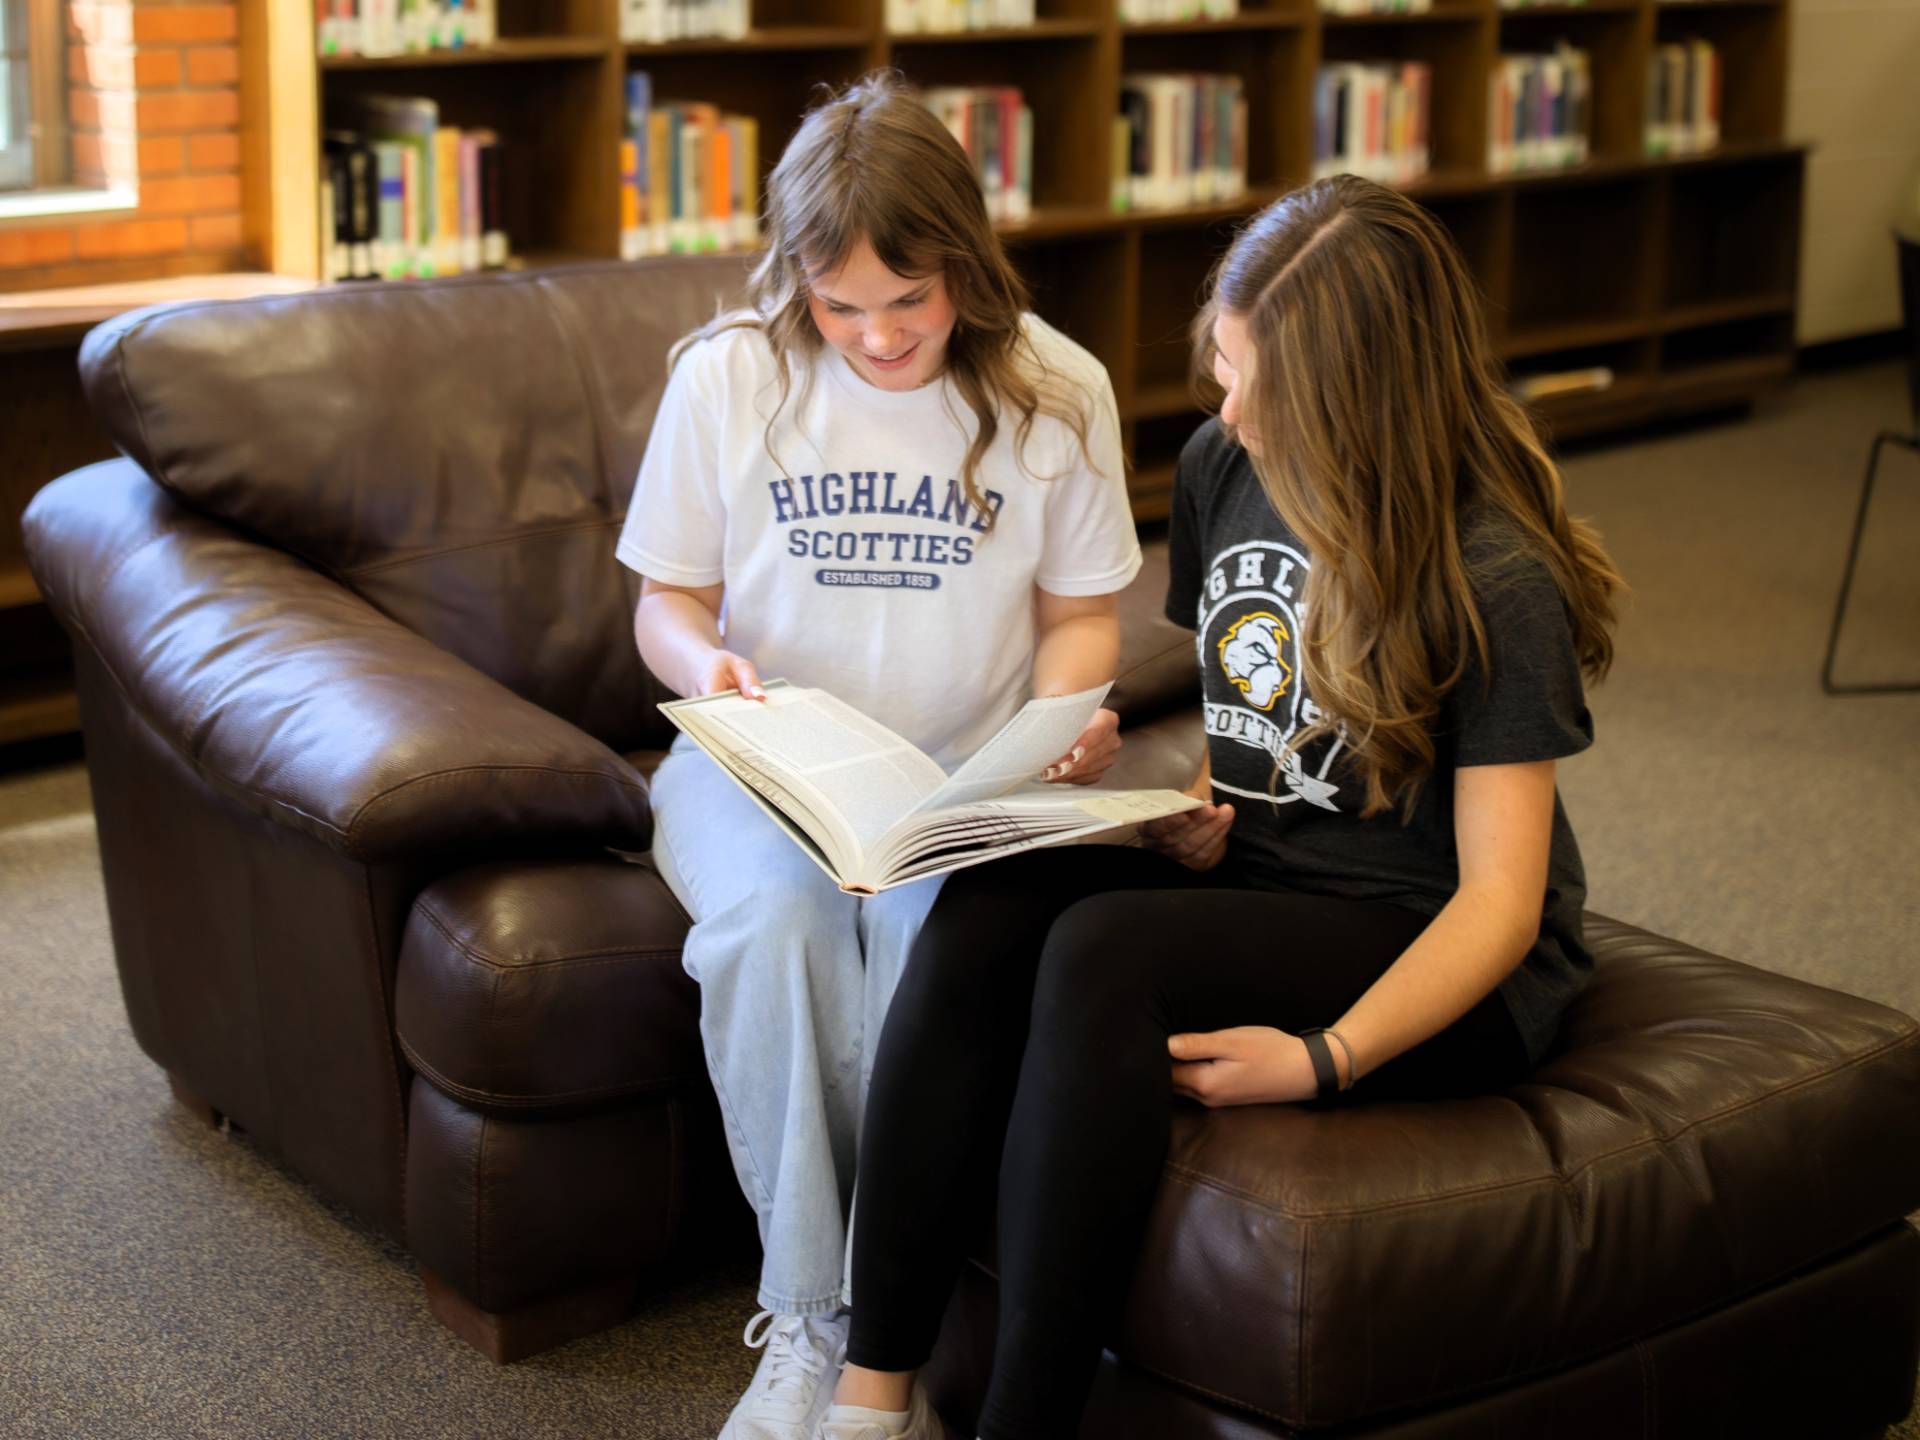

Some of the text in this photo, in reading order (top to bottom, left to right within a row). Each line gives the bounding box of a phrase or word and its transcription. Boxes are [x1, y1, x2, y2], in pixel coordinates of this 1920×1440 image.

[769, 471, 1004, 534] HIGHLAND
[788, 528, 975, 565] SCOTTIES
[823, 571, 902, 586] ESTABLISHED
